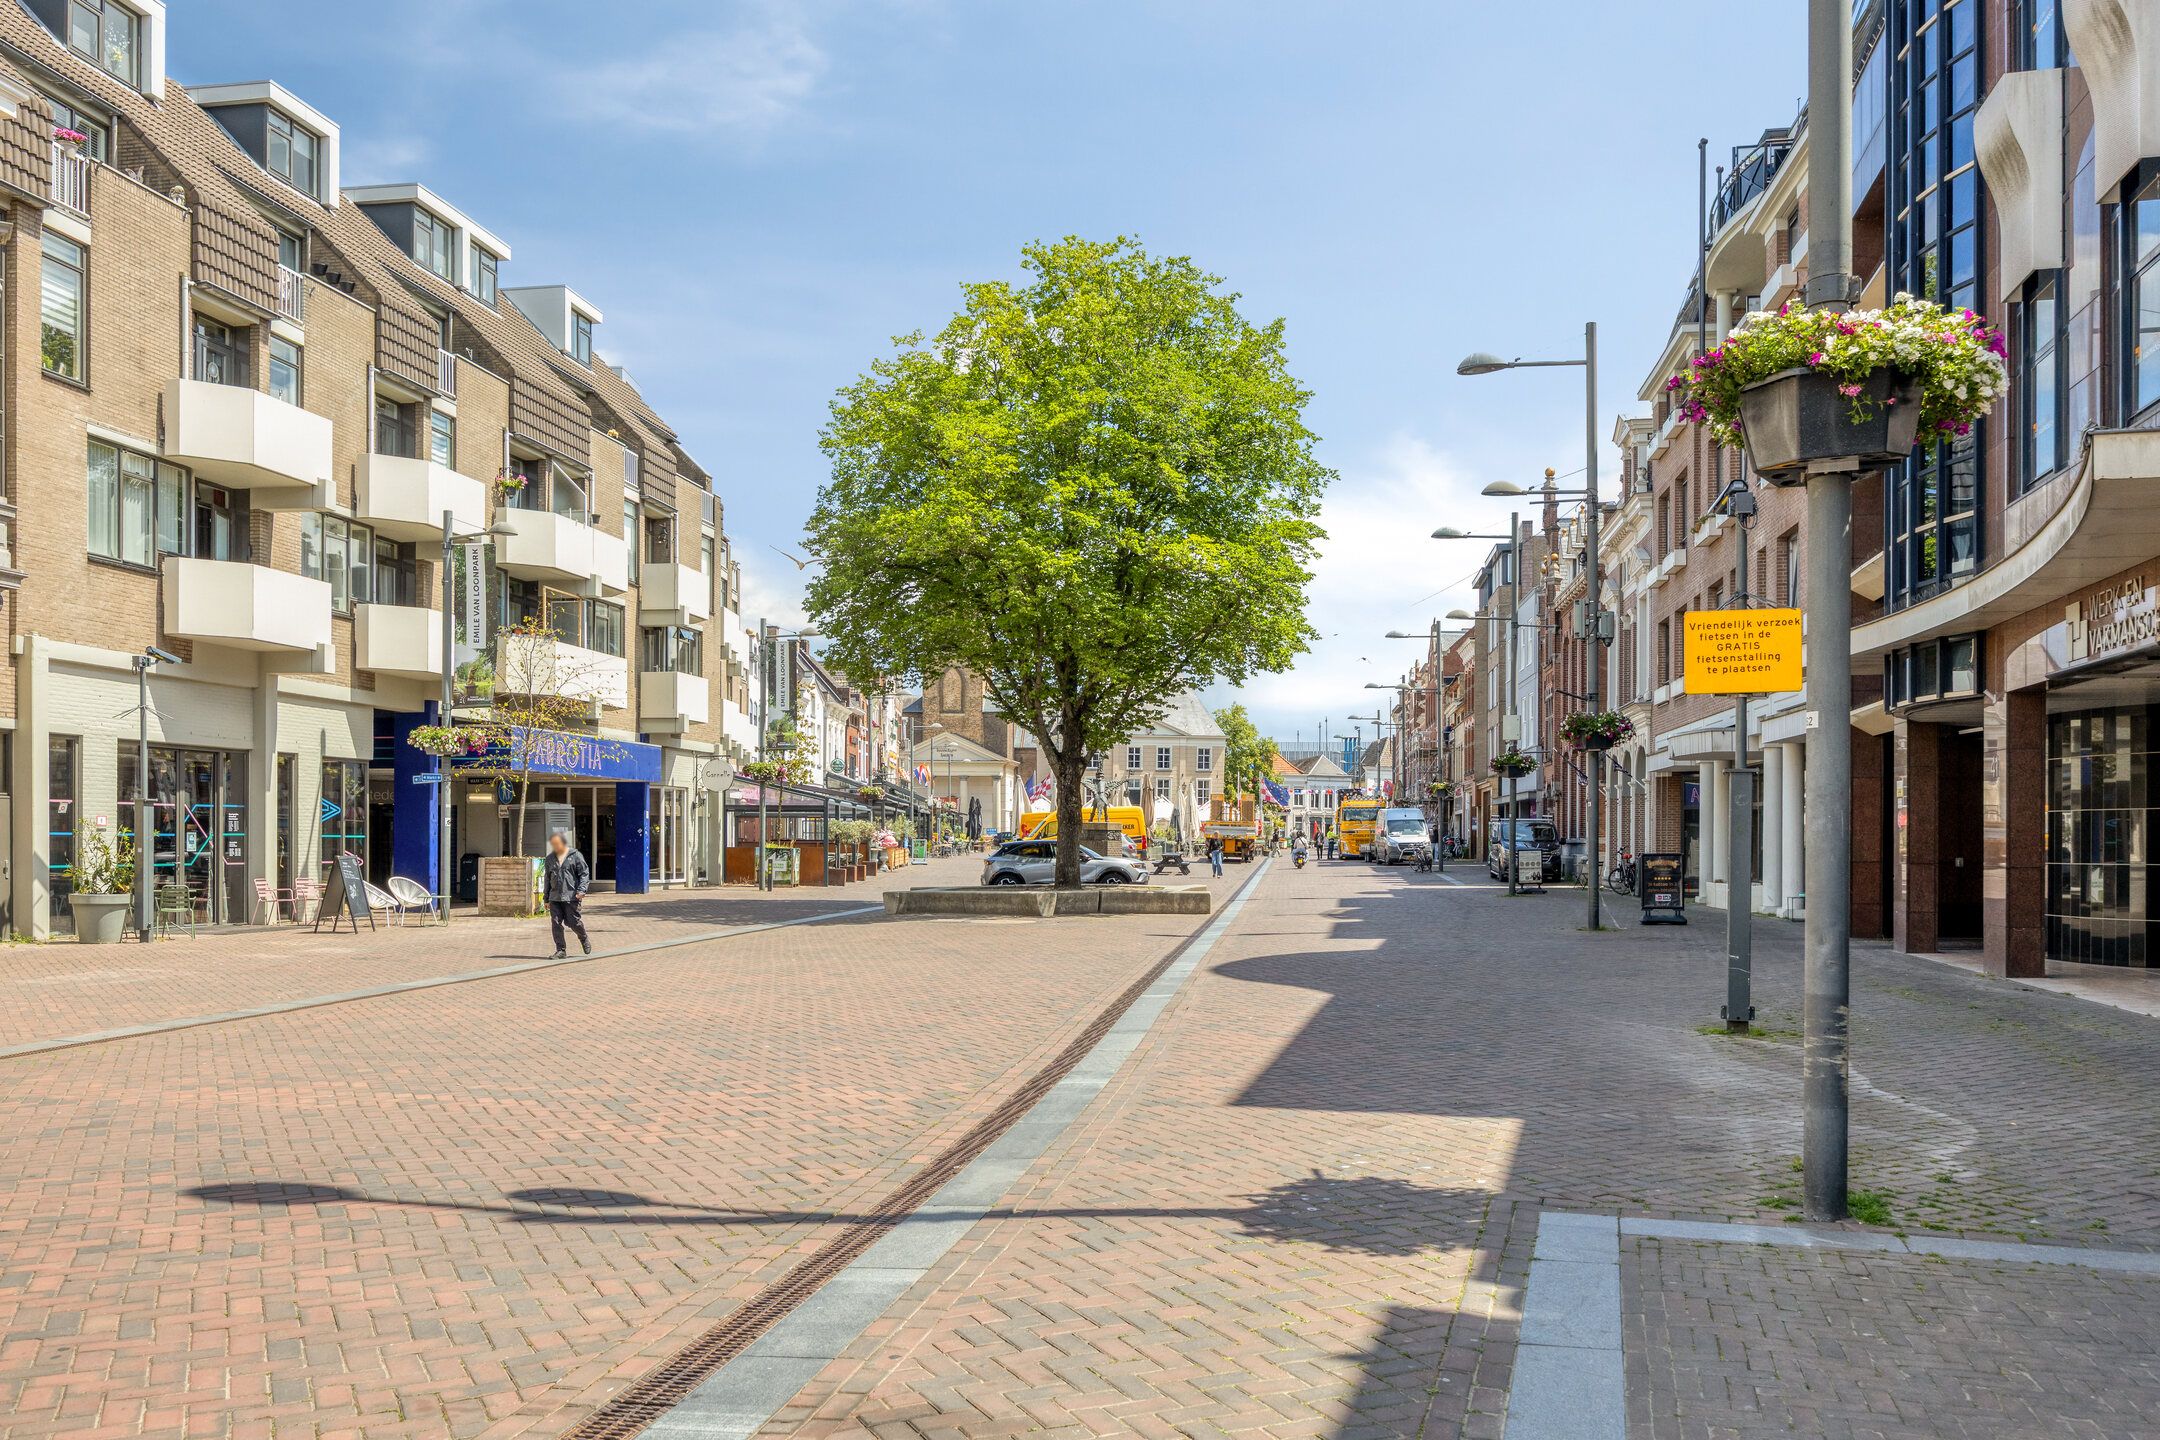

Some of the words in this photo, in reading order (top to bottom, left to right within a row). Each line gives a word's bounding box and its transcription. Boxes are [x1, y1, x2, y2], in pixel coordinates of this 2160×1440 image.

[472, 548, 480, 596] LOONPARK
[2088, 584, 2124, 621] WERK
[2125, 575, 2143, 607] EN
[1689, 620, 1752, 630] Vriendelijk
[1756, 618, 1800, 627] verzoek
[1700, 632, 1738, 641] fietsen
[1758, 630, 1771, 638] de
[1717, 642, 1760, 652] GRATIS
[1696, 652, 1781, 664] fietsenstalling
[1722, 664, 1771, 674] plaatsen
